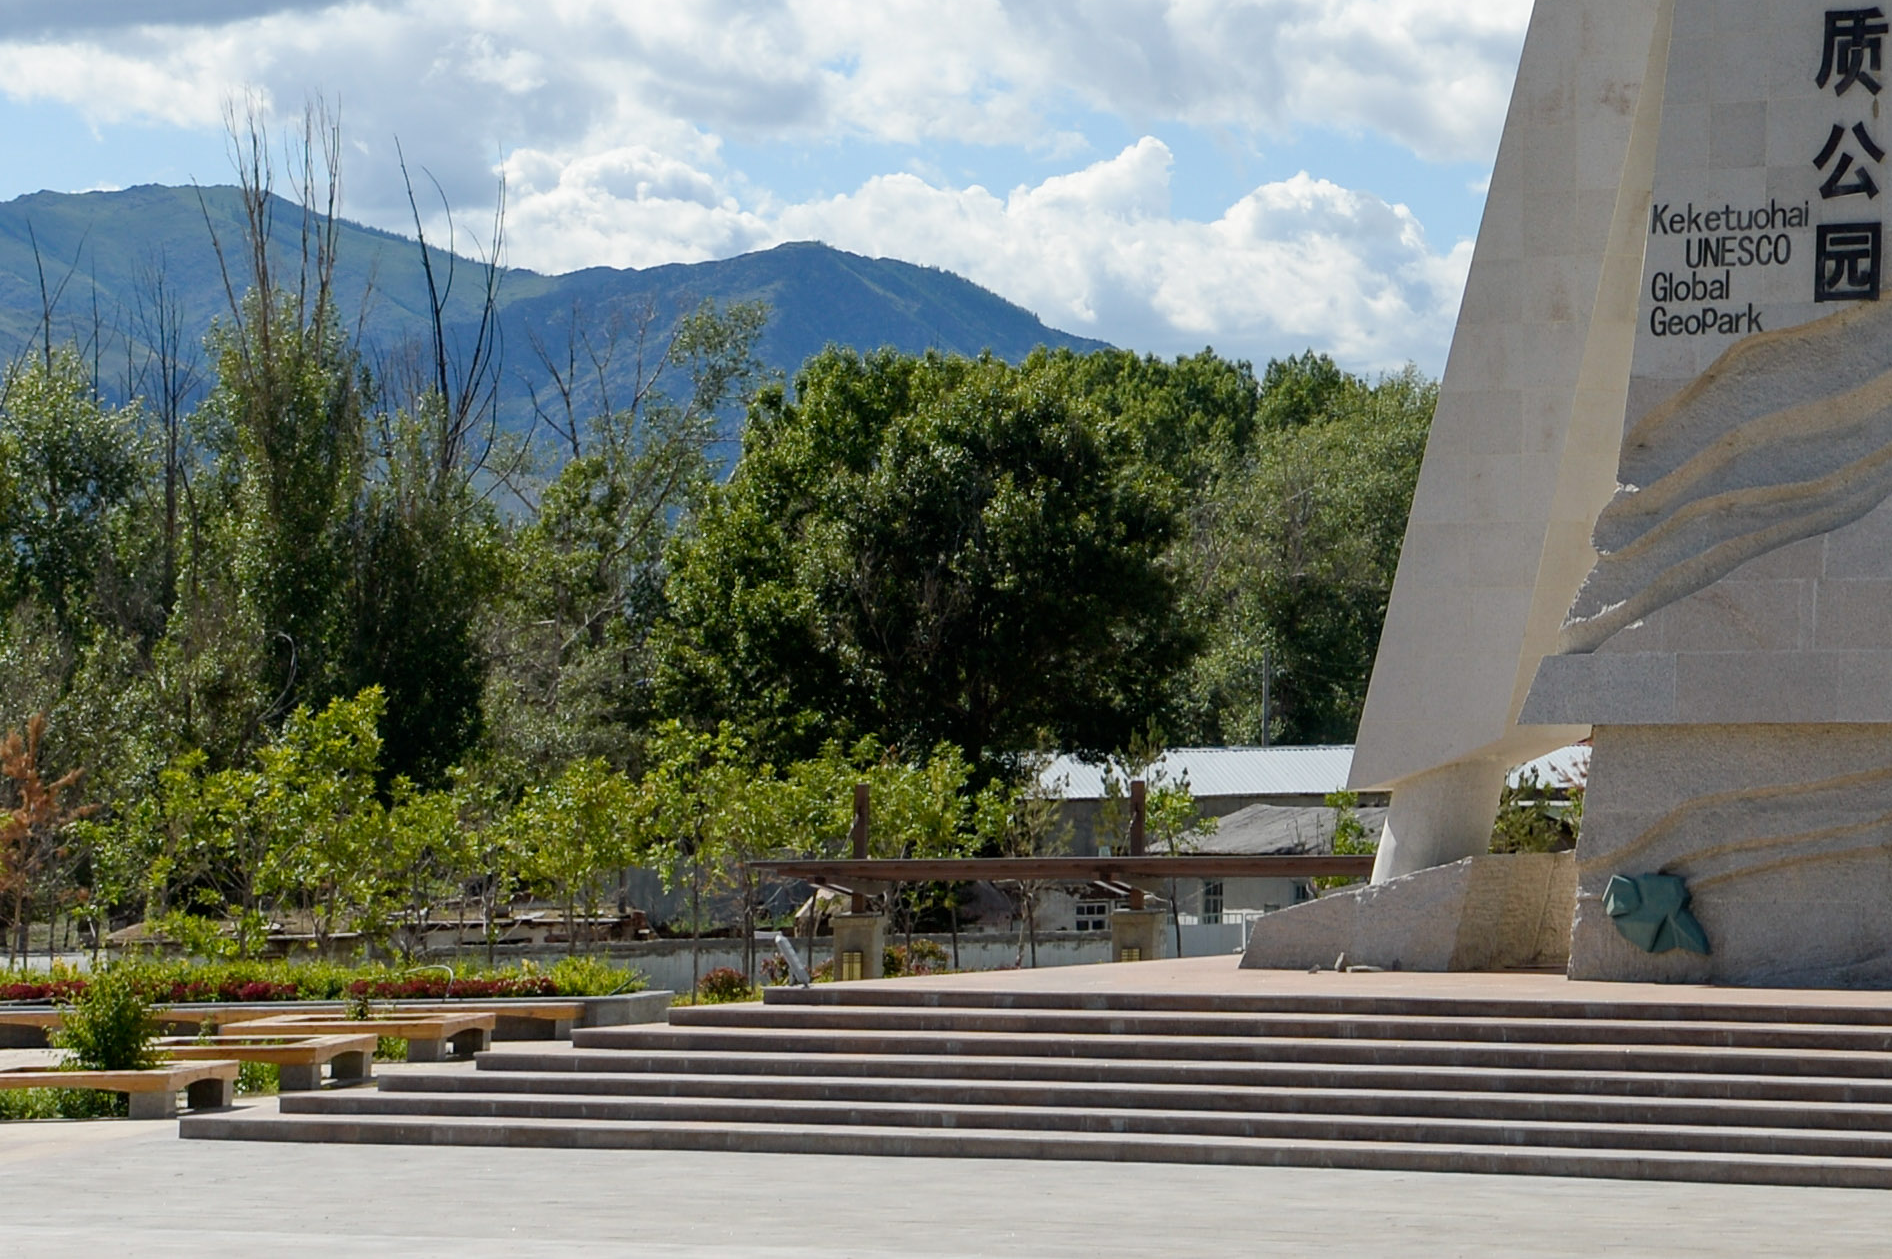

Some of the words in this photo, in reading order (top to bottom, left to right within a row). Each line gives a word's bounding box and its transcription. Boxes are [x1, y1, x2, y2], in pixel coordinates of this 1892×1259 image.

[1651, 199, 1809, 234] Keketuohai
[1685, 234, 1791, 268] UNESCO
[1651, 270, 1730, 303] Global
[1650, 303, 1763, 336] GeoPark
